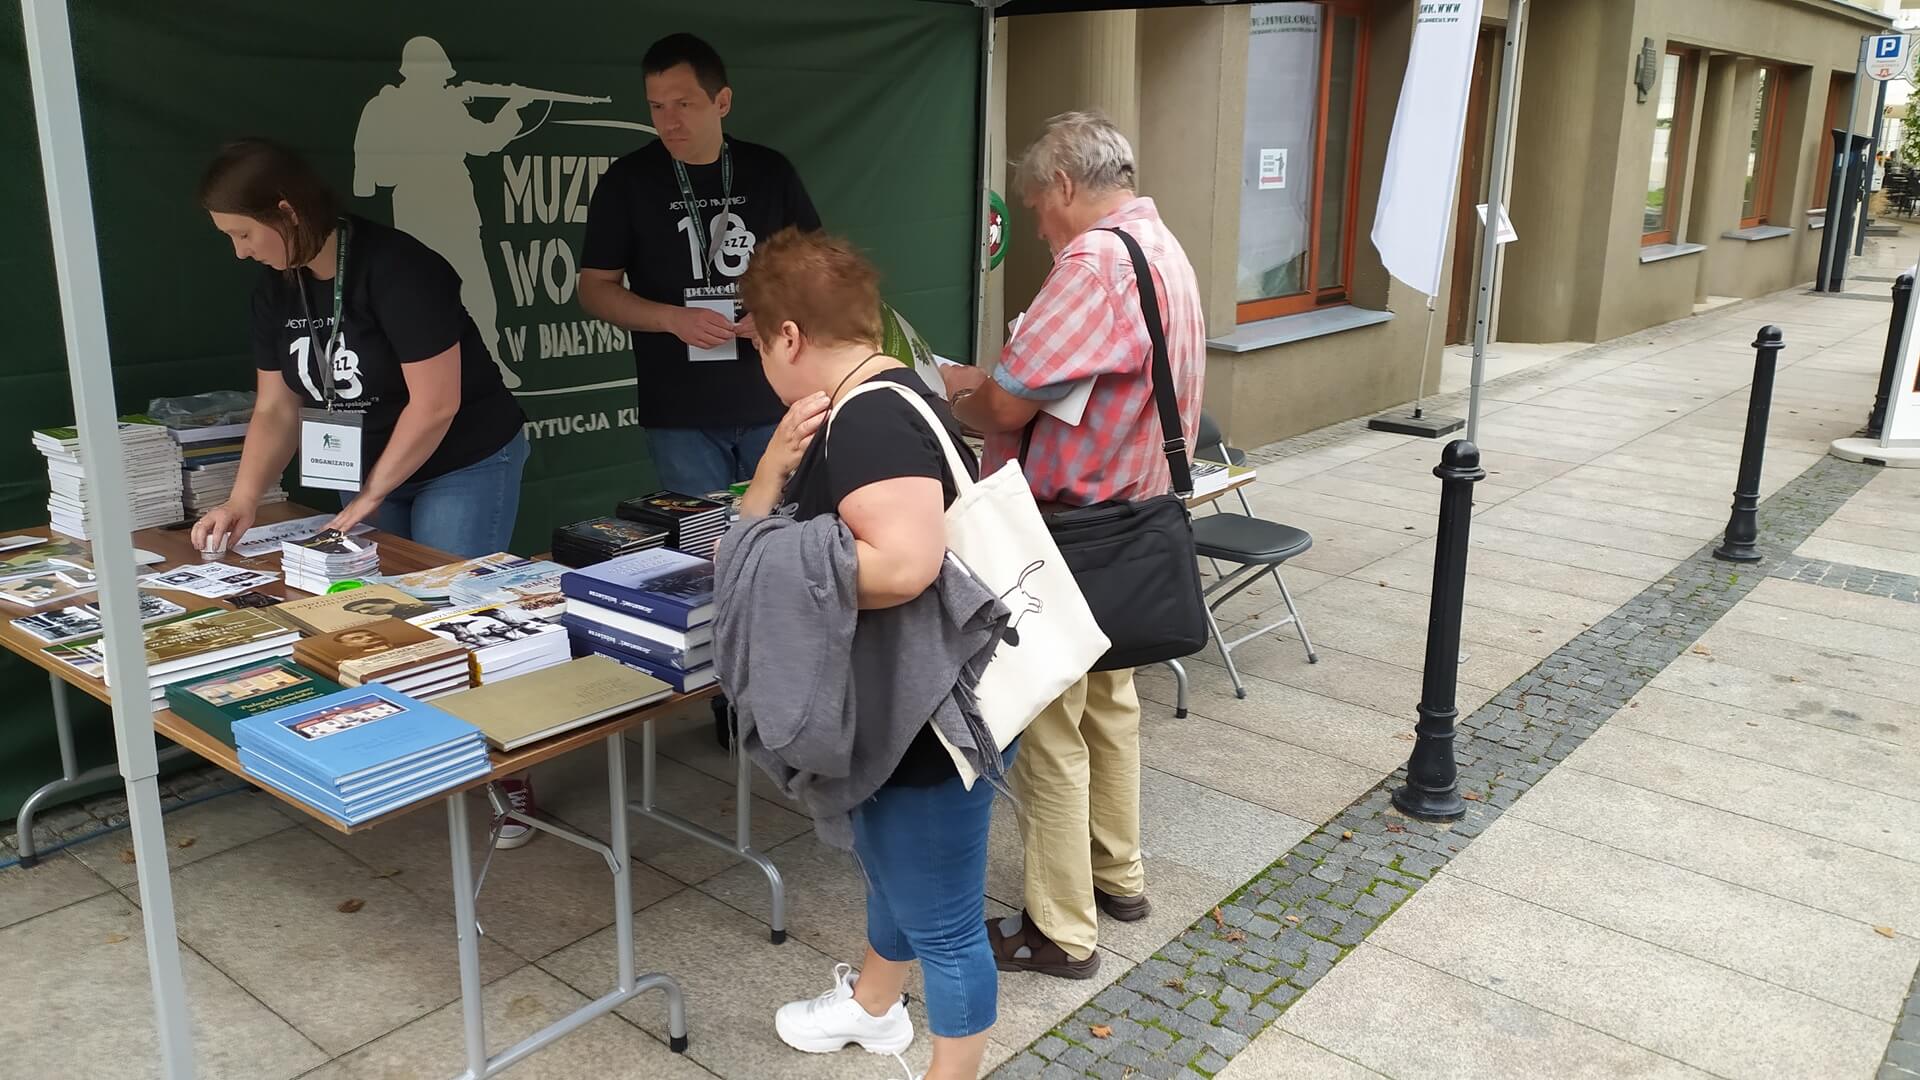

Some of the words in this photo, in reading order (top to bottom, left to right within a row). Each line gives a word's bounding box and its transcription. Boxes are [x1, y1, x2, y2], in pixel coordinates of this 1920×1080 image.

[1881, 39, 1897, 56] P
[503, 155, 618, 224] MUZE
[500, 237, 581, 306] WO
[504, 326, 527, 362] W
[310, 457, 354, 468] ORGANIZATOR
